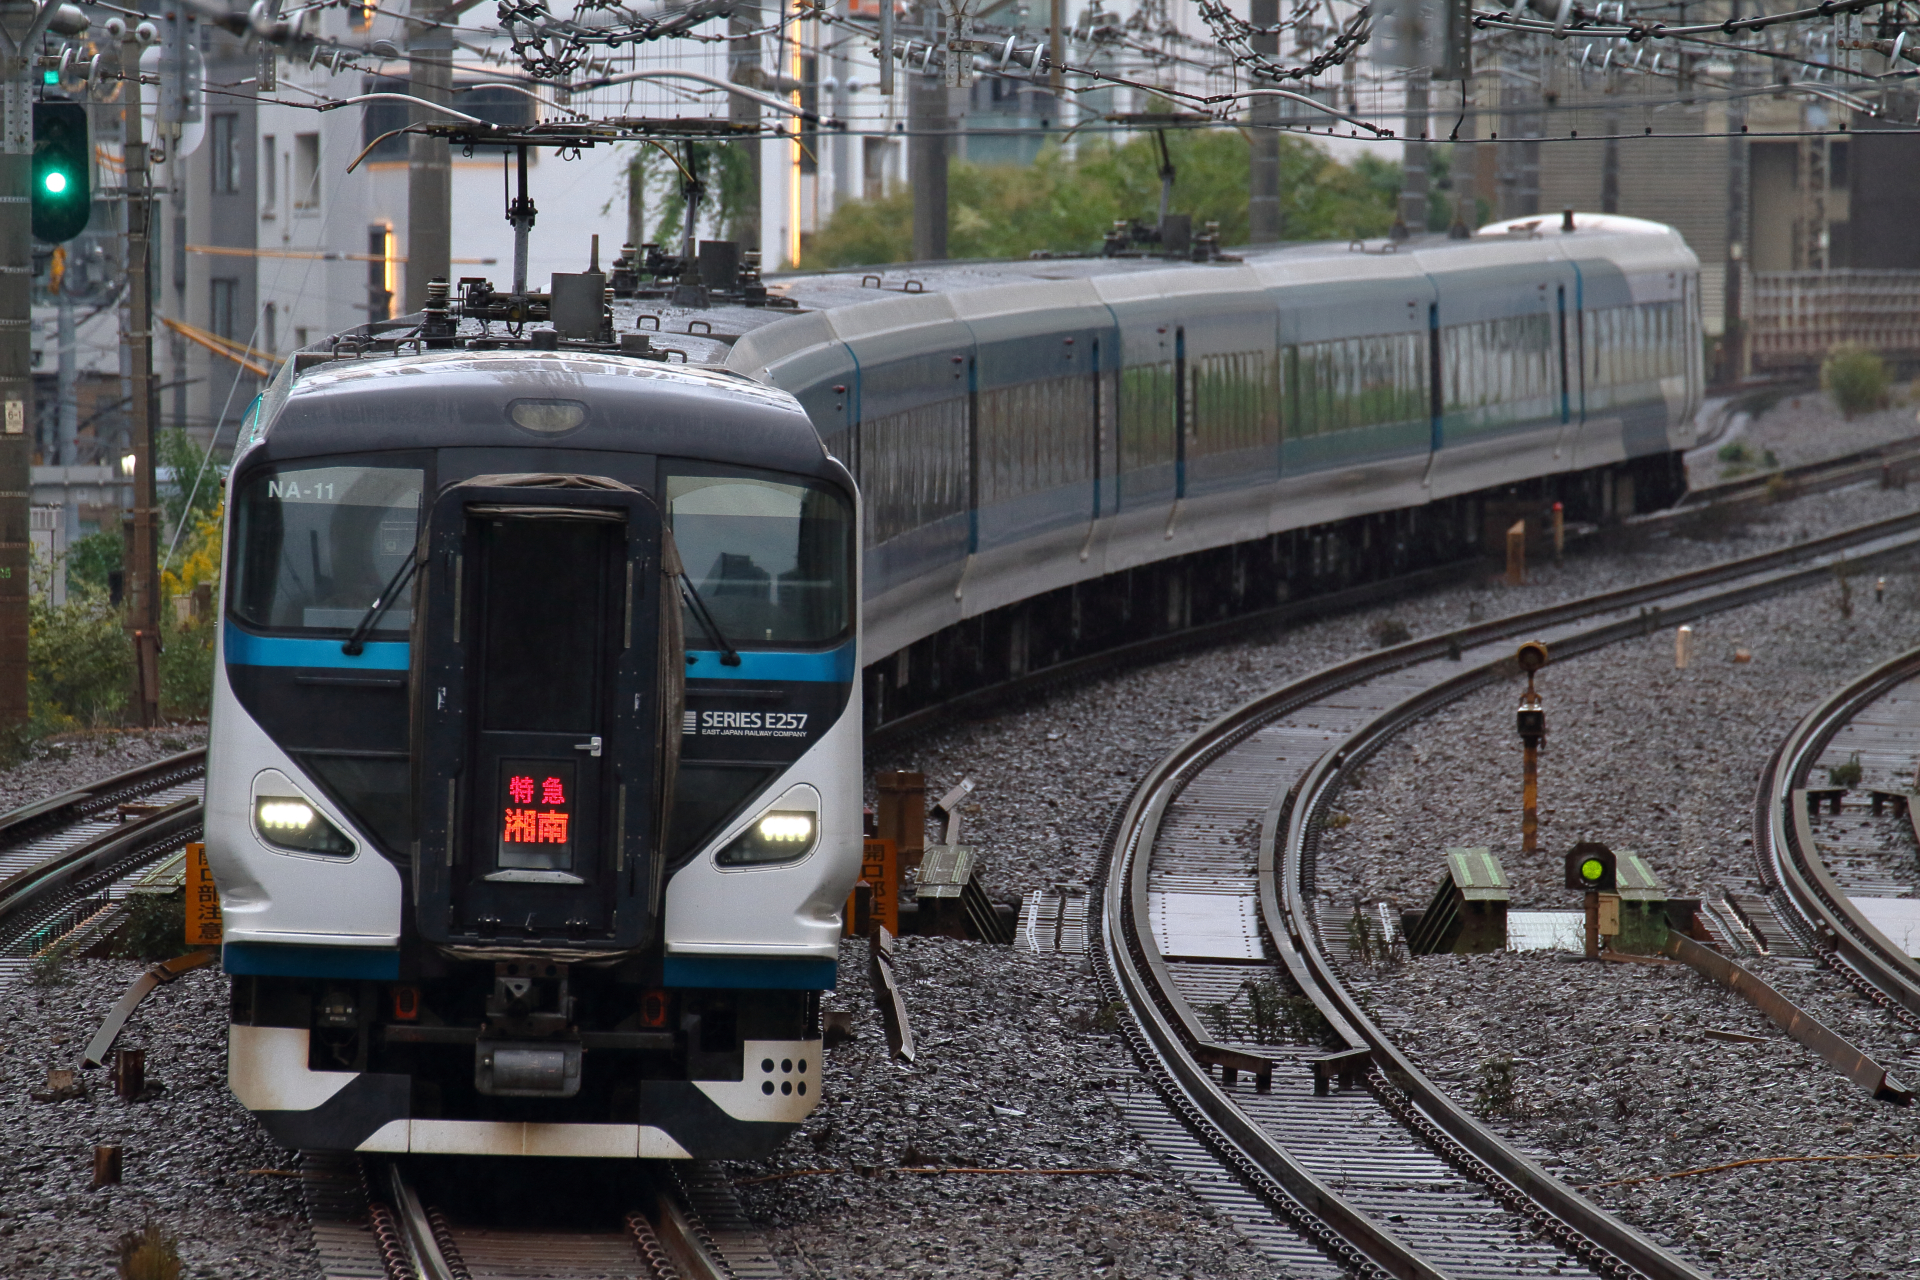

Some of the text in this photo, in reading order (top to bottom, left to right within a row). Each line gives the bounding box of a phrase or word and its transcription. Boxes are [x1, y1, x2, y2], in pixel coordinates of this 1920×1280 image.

[268, 480, 334, 500] NA-11
[702, 711, 808, 729] SERIES E257
[509, 775, 566, 805] 特急
[504, 808, 569, 844] 湘南
